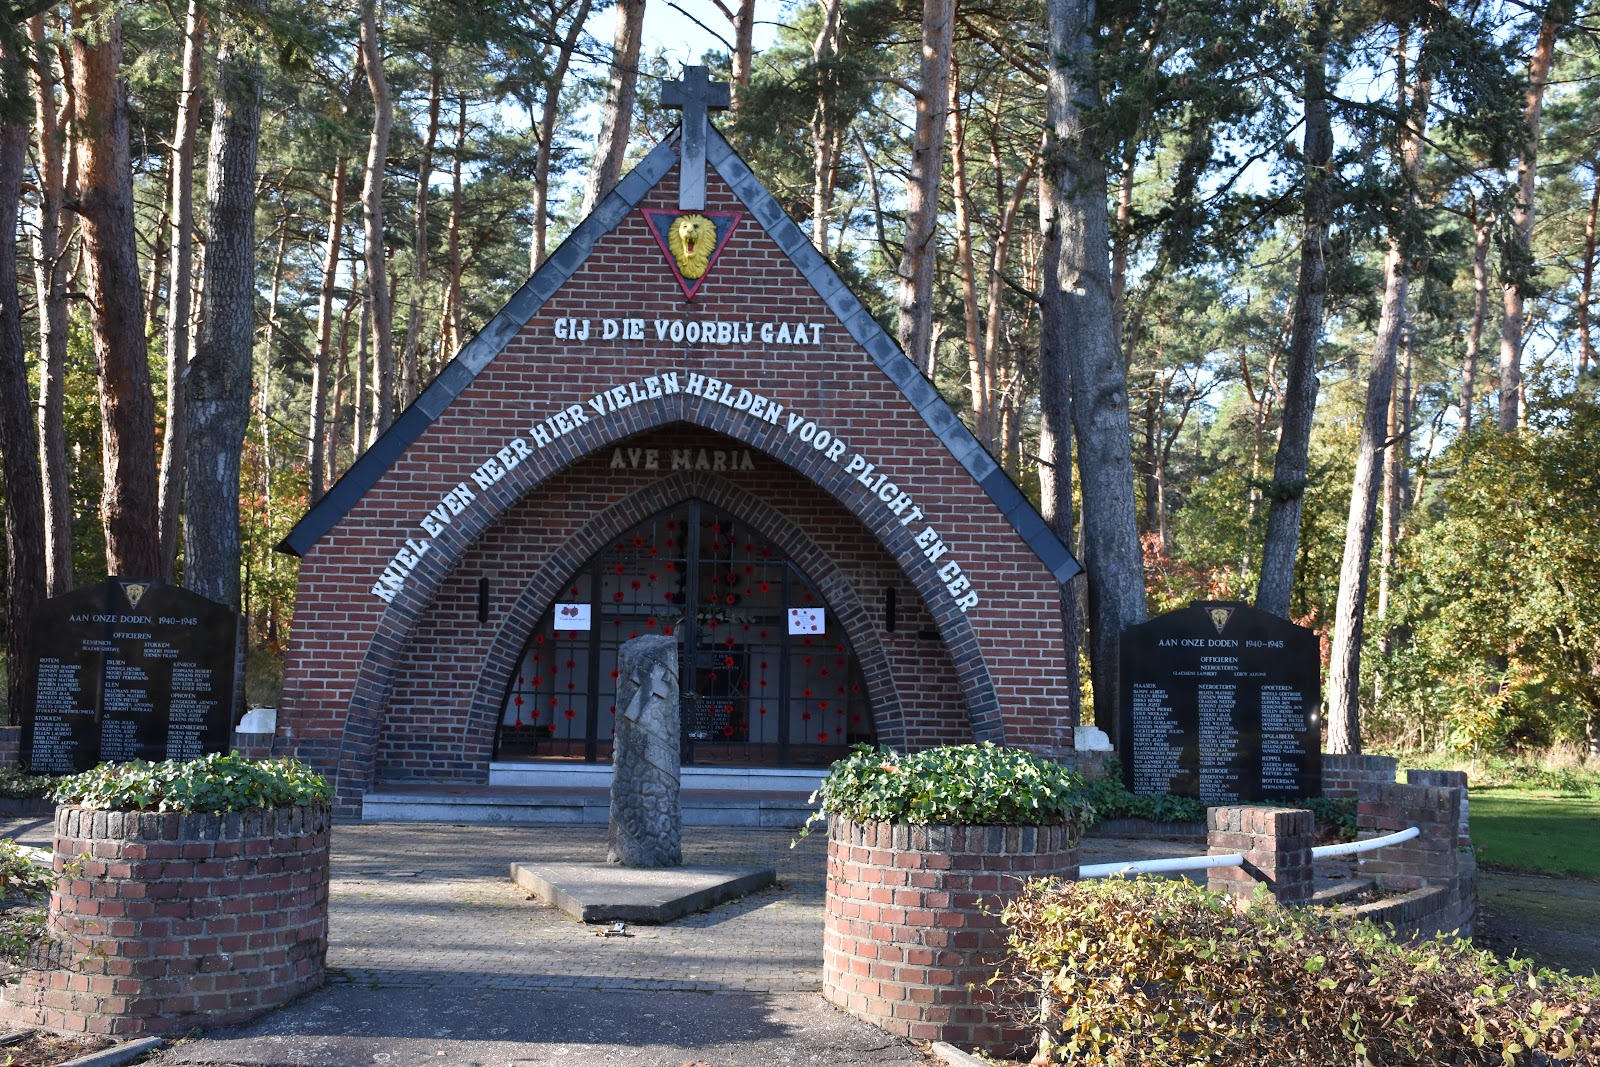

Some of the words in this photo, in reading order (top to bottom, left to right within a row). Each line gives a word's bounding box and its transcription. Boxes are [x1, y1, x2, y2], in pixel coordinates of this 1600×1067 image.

[554, 318, 591, 341] GIJ
[603, 319, 645, 340] DIE
[654, 320, 753, 343] VOORBIJ
[760, 322, 825, 345] GAAT
[610, 448, 659, 469] AVE
[671, 449, 756, 471] MARIA
[371, 538, 430, 603] KNIEL
[419, 482, 477, 539] EVEN
[470, 437, 534, 491] NEER
[530, 404, 590, 448] HIER
[588, 371, 679, 417] VIELEN
[687, 373, 783, 425] HELDEN
[786, 412, 847, 463] VOOR
[844, 453, 924, 527] PLICHT
[915, 525, 948, 563] EN
[938, 560, 979, 613] EER
[158, 617, 197, 625] 1940-1945
